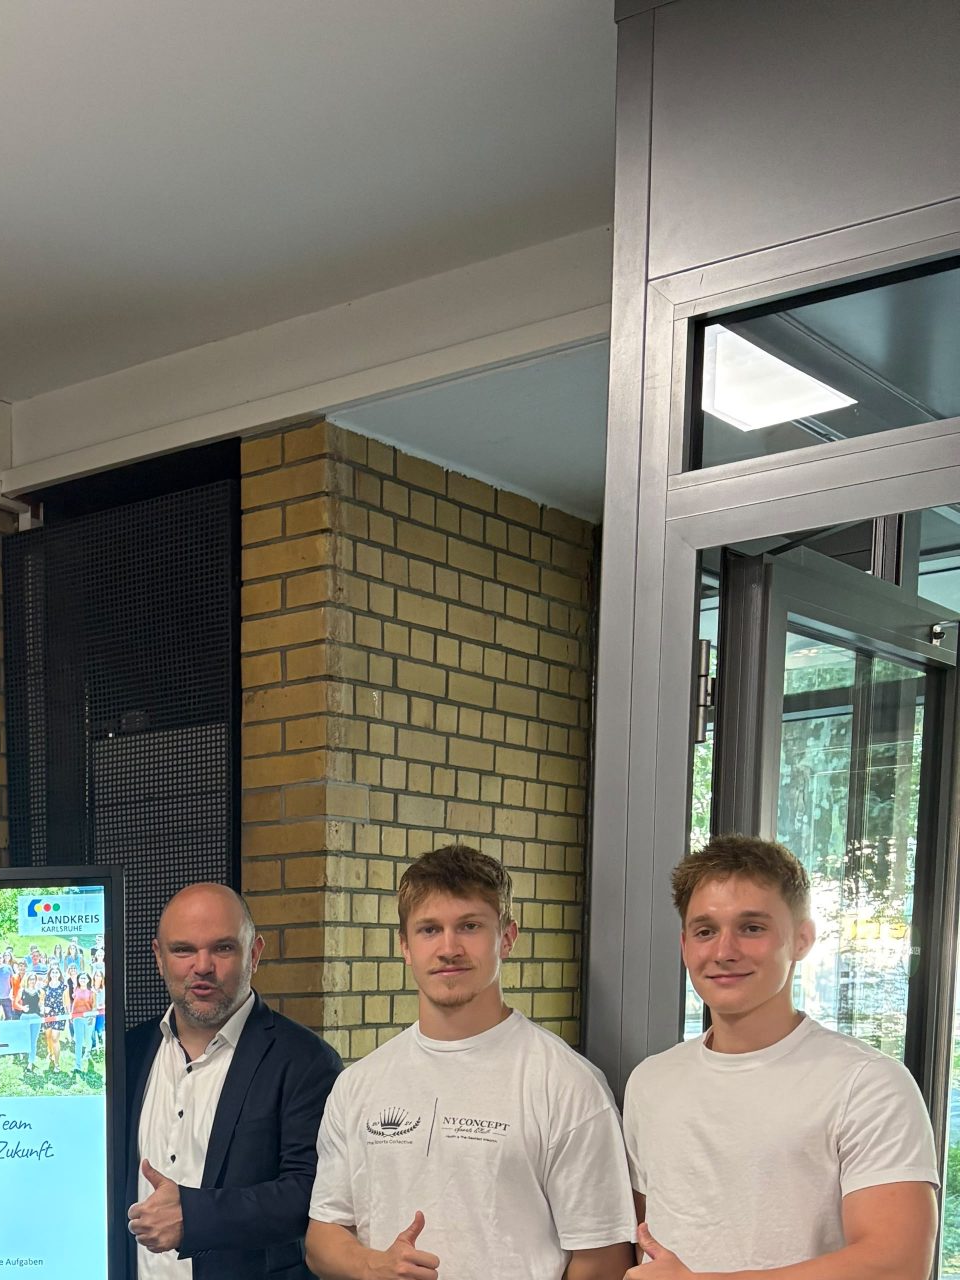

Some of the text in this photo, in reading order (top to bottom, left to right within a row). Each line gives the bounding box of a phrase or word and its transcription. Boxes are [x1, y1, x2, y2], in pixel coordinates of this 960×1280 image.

[41, 914, 100, 925] LANDKREIS
[41, 925, 83, 933] KARLSRUHE
[5, 1257, 43, 1267] Aufgaben
